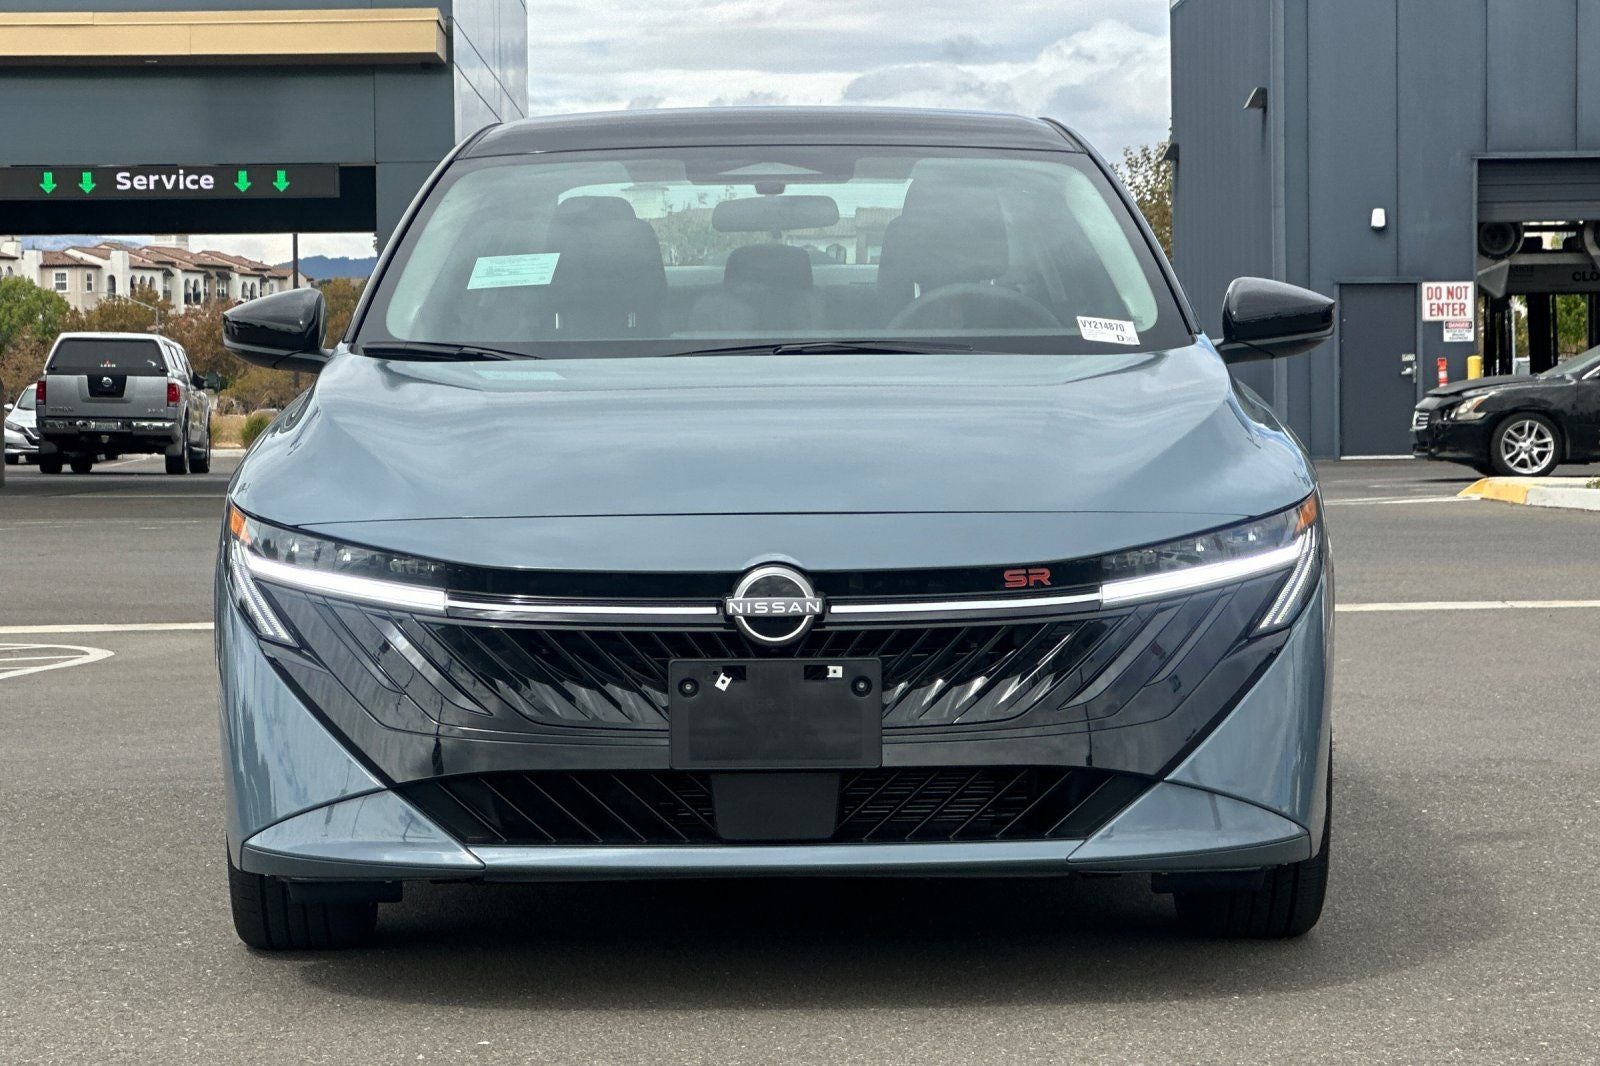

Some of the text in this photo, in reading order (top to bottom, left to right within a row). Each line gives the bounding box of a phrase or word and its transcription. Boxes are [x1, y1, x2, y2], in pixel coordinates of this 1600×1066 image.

[116, 169, 215, 190] Service
[1426, 286, 1469, 300] DO NOT
[1429, 303, 1467, 317] ENTER
[1004, 568, 1052, 587] SR
[729, 601, 821, 614] NISSAN
